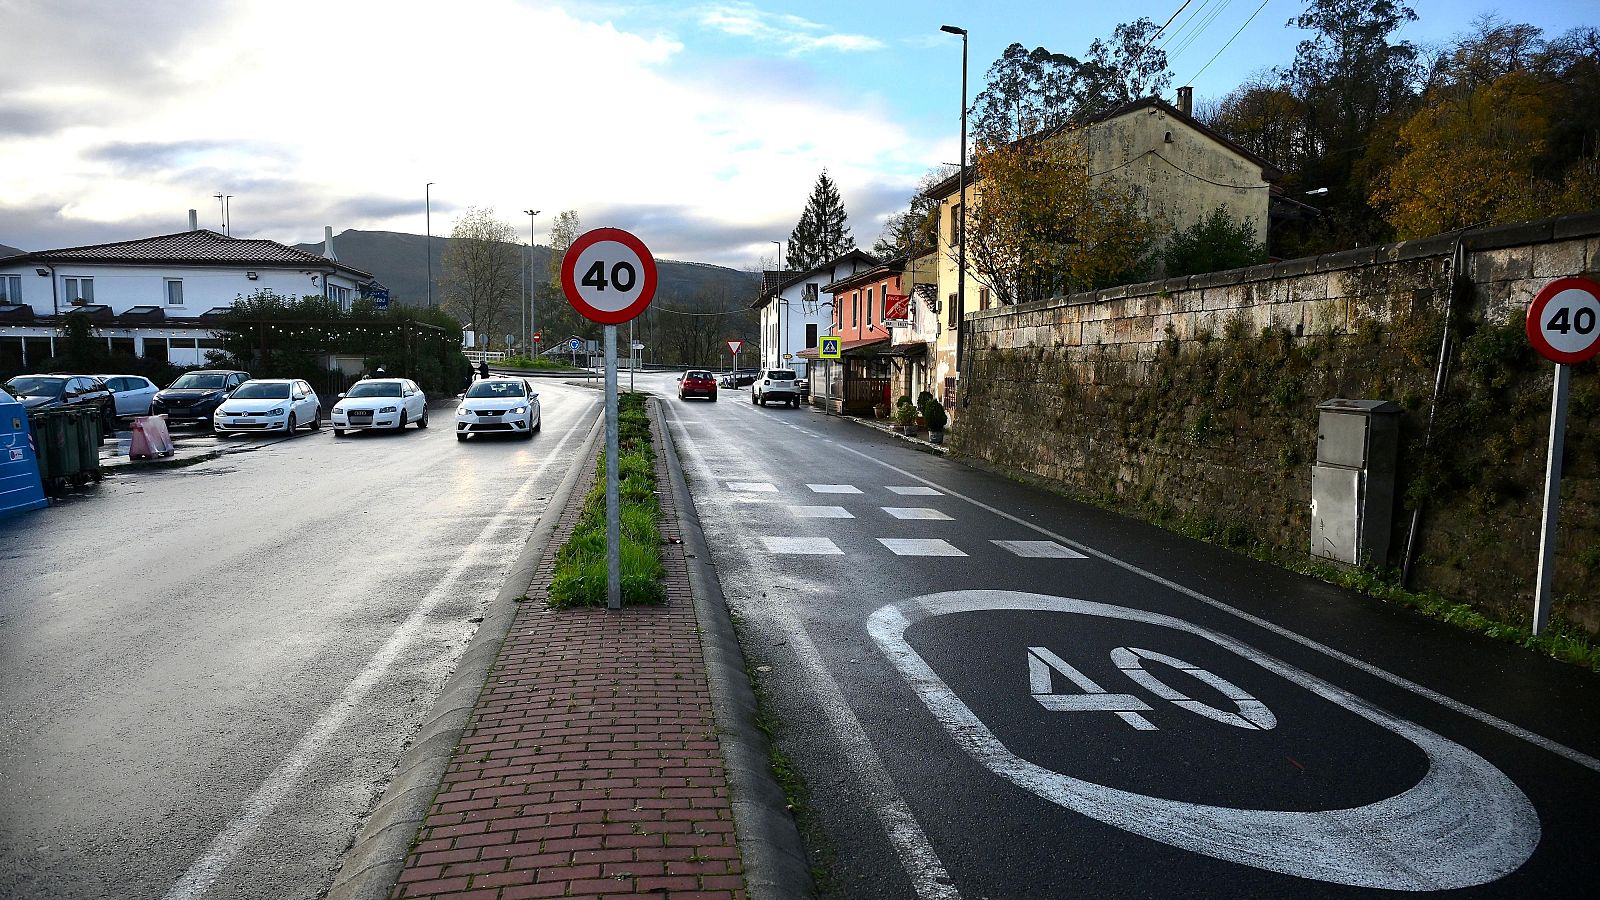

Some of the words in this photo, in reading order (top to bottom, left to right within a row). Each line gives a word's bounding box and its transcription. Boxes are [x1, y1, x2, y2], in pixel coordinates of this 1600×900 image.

[581, 261, 637, 292] 40
[1547, 307, 1597, 335] 40
[1028, 646, 1277, 731] 40
